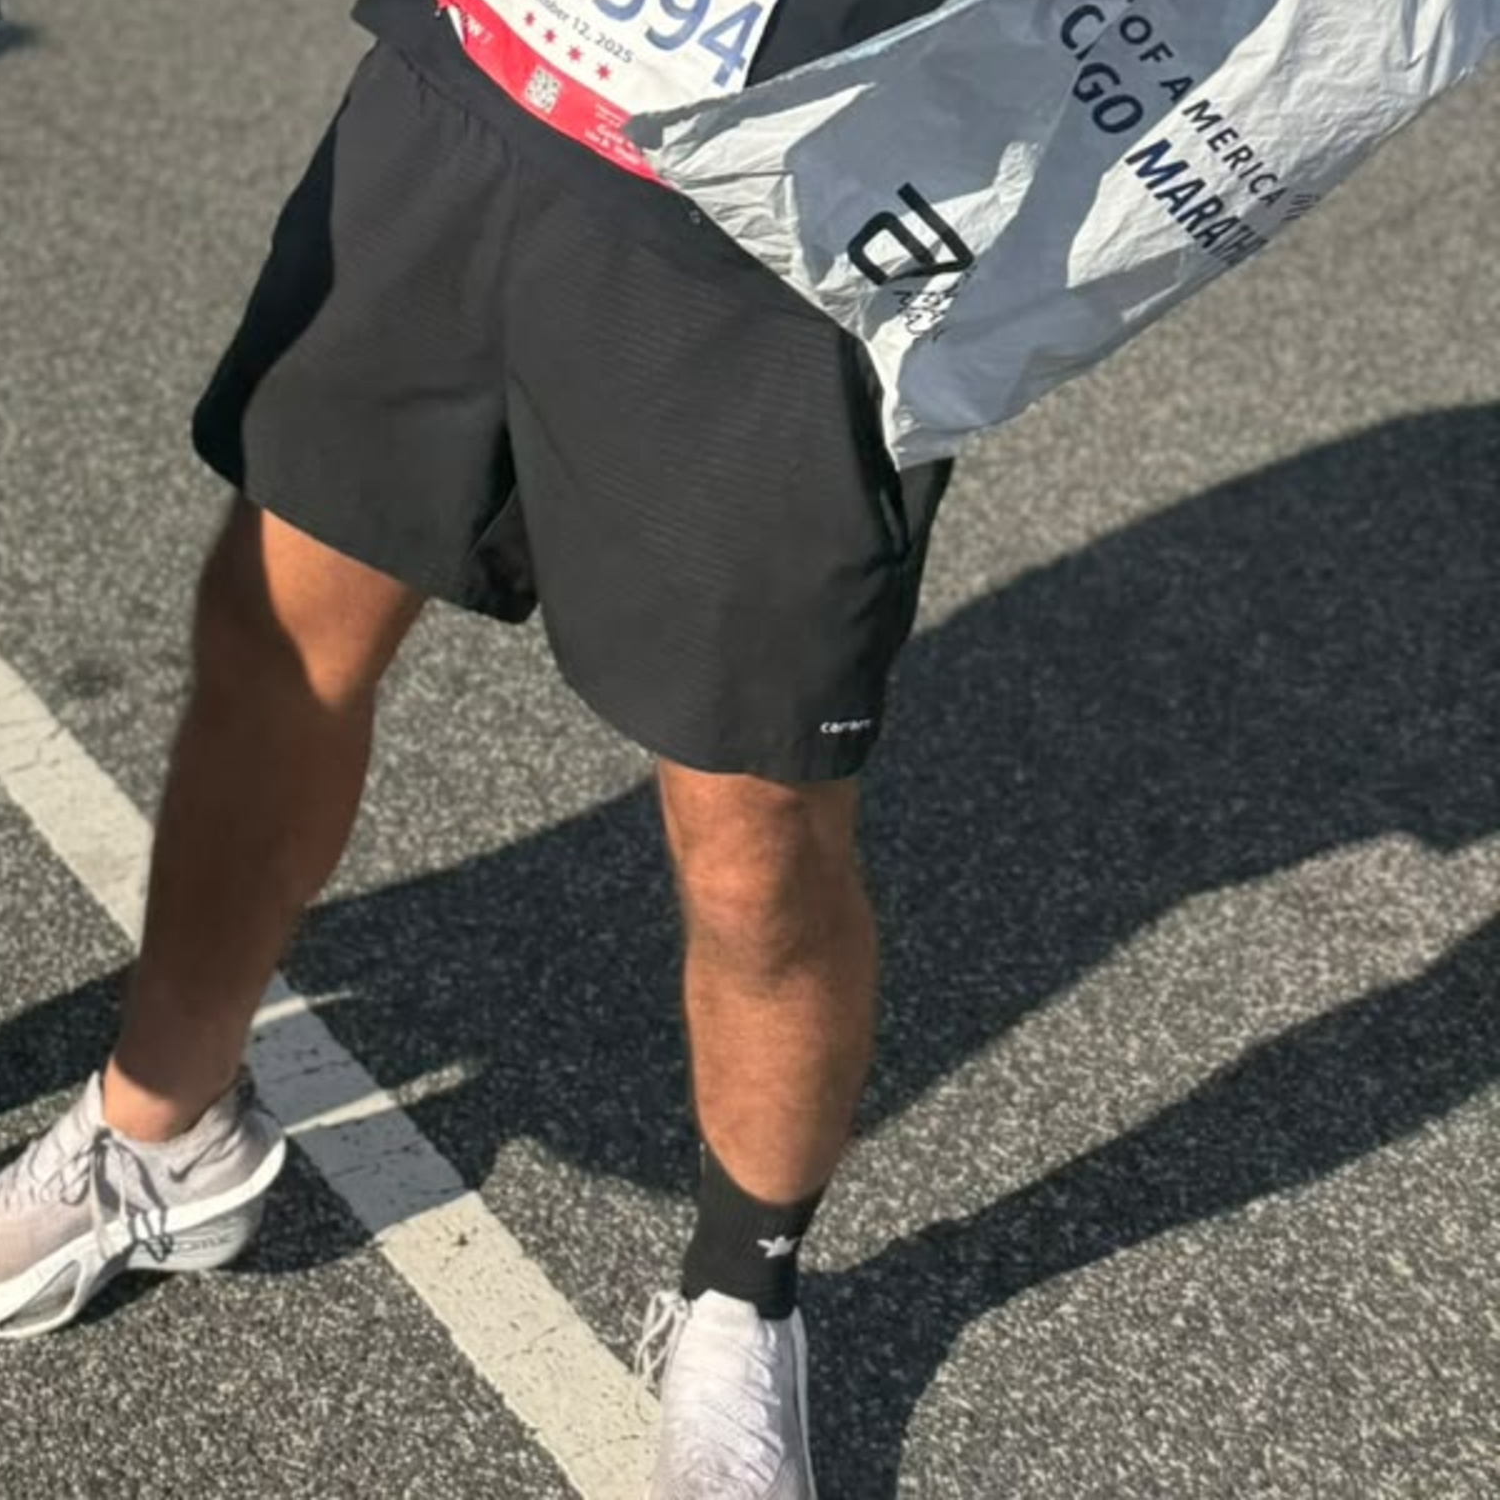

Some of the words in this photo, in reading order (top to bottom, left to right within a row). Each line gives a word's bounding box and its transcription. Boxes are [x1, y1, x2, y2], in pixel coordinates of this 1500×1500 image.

[571, 17, 593, 42] 12,
[593, 34, 635, 65] 2025
[1118, 14, 1175, 64] OF
[1159, 75, 1288, 208] AMERICA
